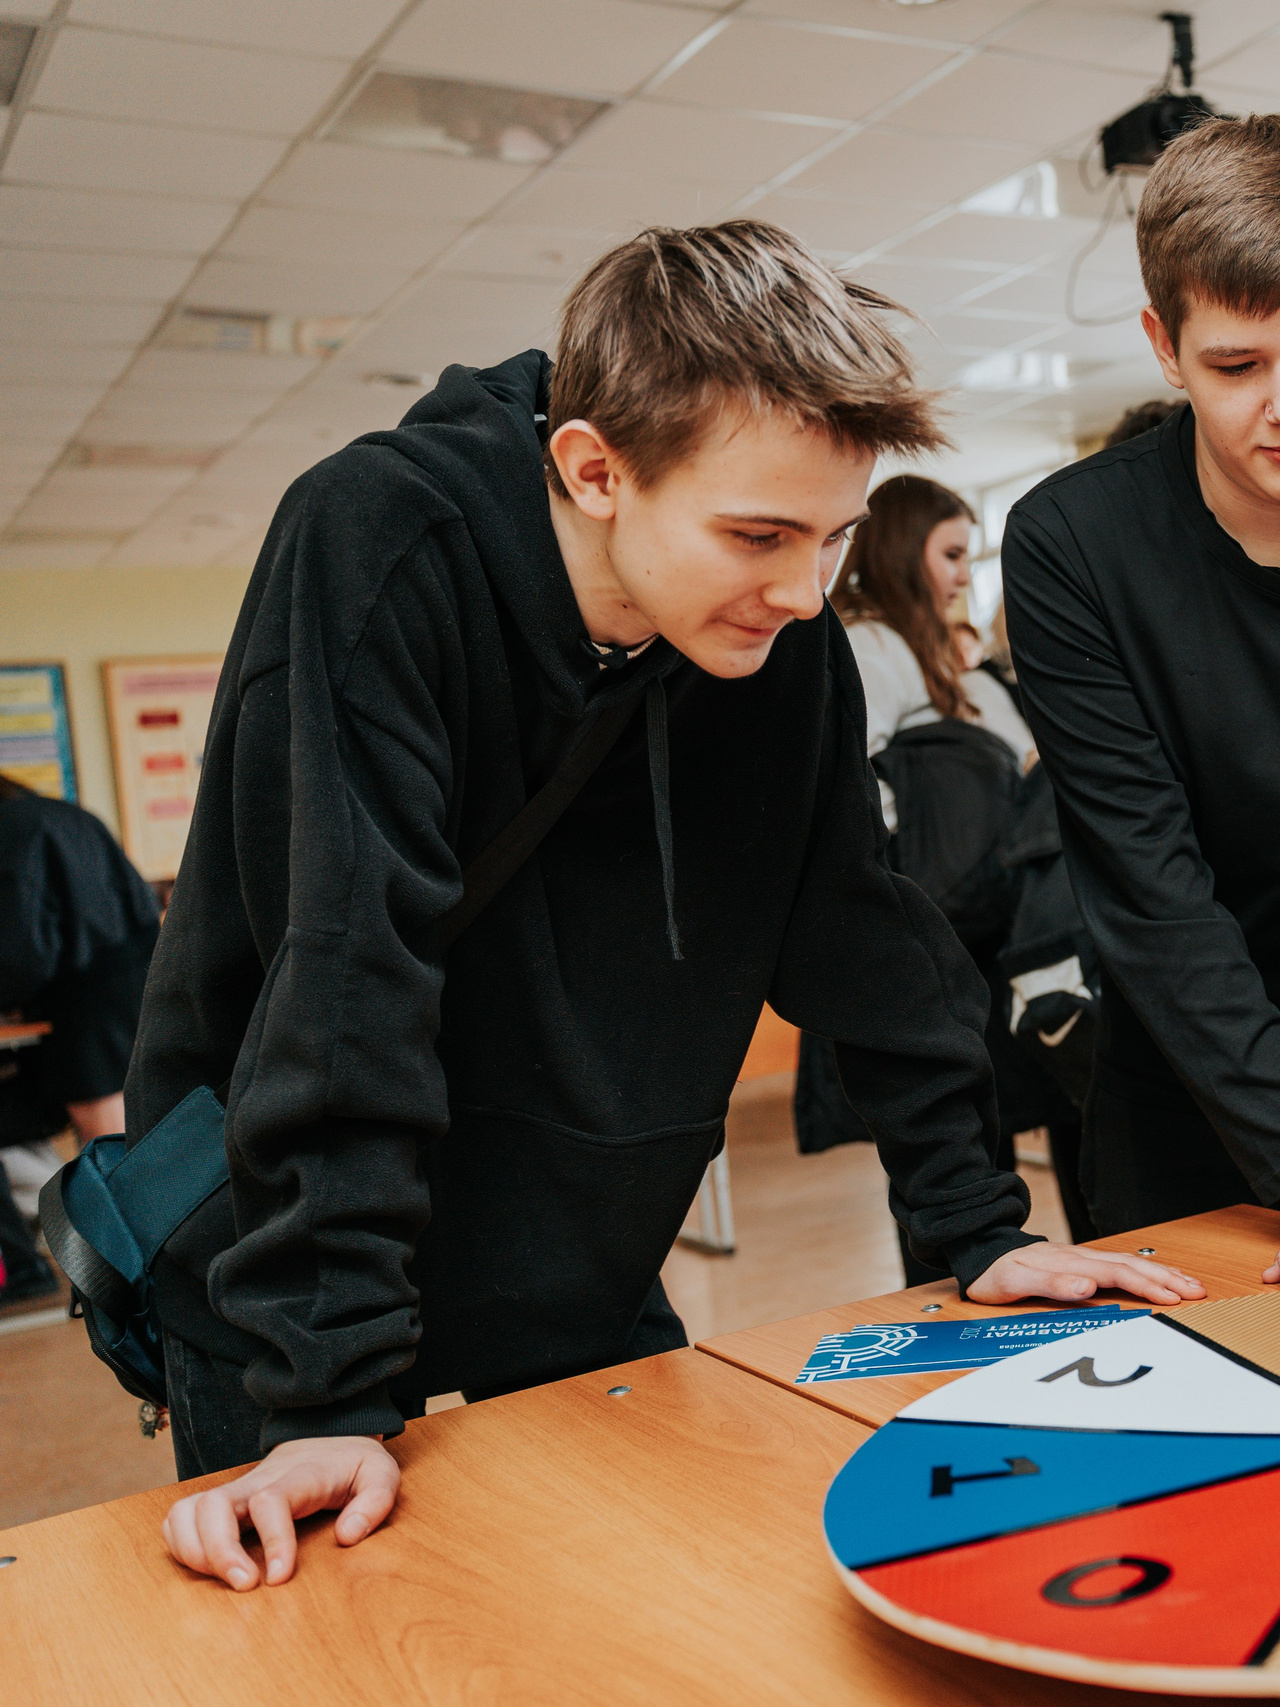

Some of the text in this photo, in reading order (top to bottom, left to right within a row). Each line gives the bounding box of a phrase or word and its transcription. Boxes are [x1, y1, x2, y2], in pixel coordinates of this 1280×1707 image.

[983, 1326, 1096, 1339] АЛАВРИАТ
[1036, 1356, 1153, 1388] 2
[928, 1456, 1042, 1498] 1
